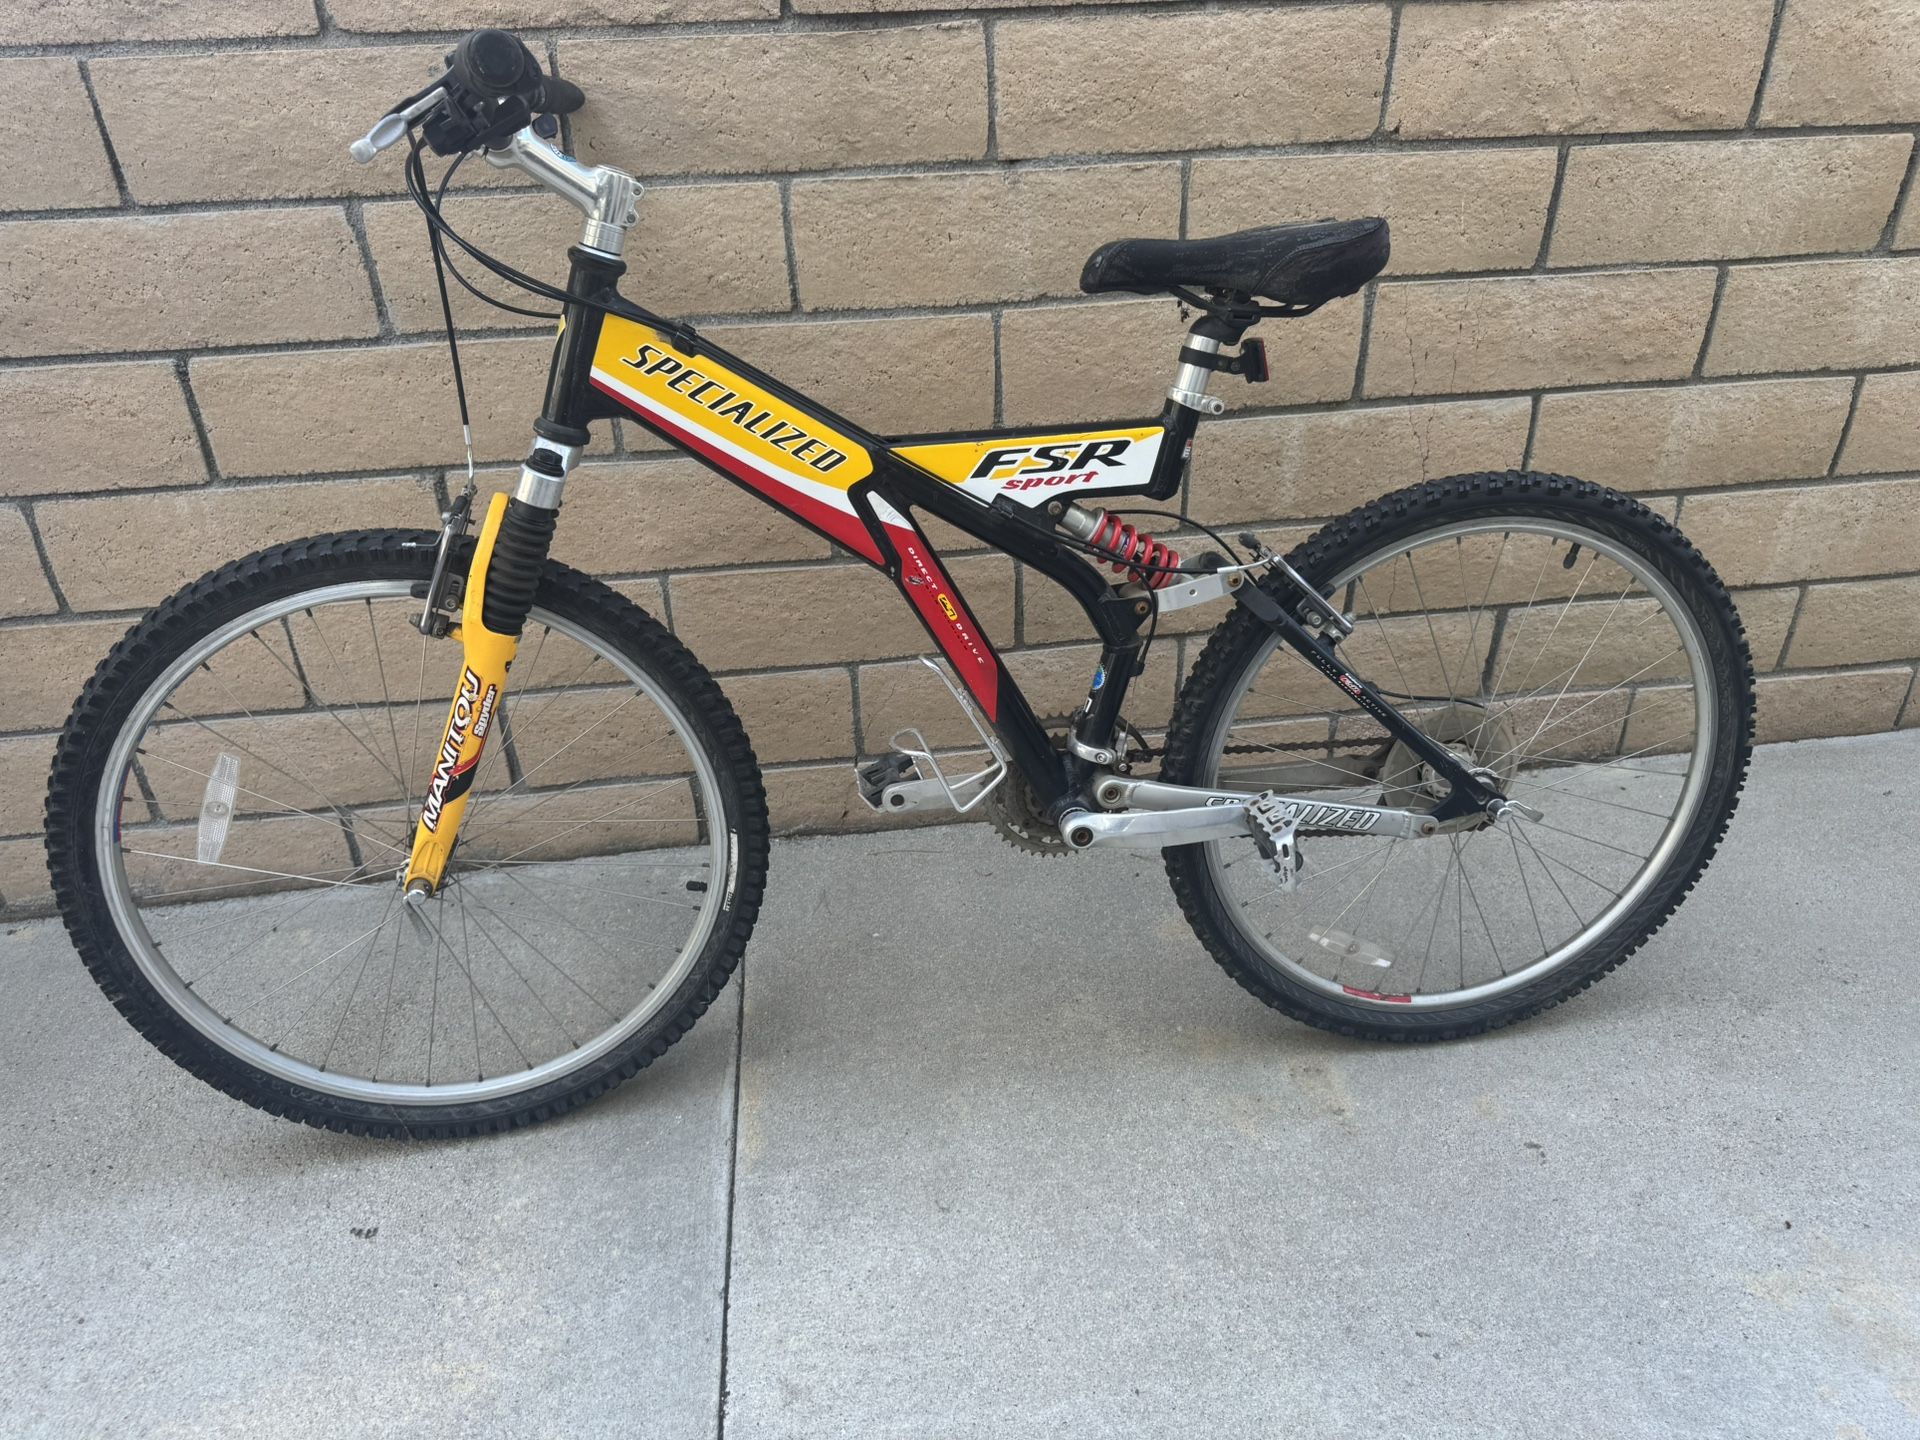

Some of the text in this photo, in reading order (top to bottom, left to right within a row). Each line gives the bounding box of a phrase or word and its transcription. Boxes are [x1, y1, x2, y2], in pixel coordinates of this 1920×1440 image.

[620, 343, 849, 474] SPECIALIZED
[969, 438, 1132, 480] FSR
[1001, 470, 1099, 491] sport
[907, 546, 985, 664] DIRECT DRIVE
[422, 665, 483, 834] MANITOU
[473, 684, 497, 738] Spyder
